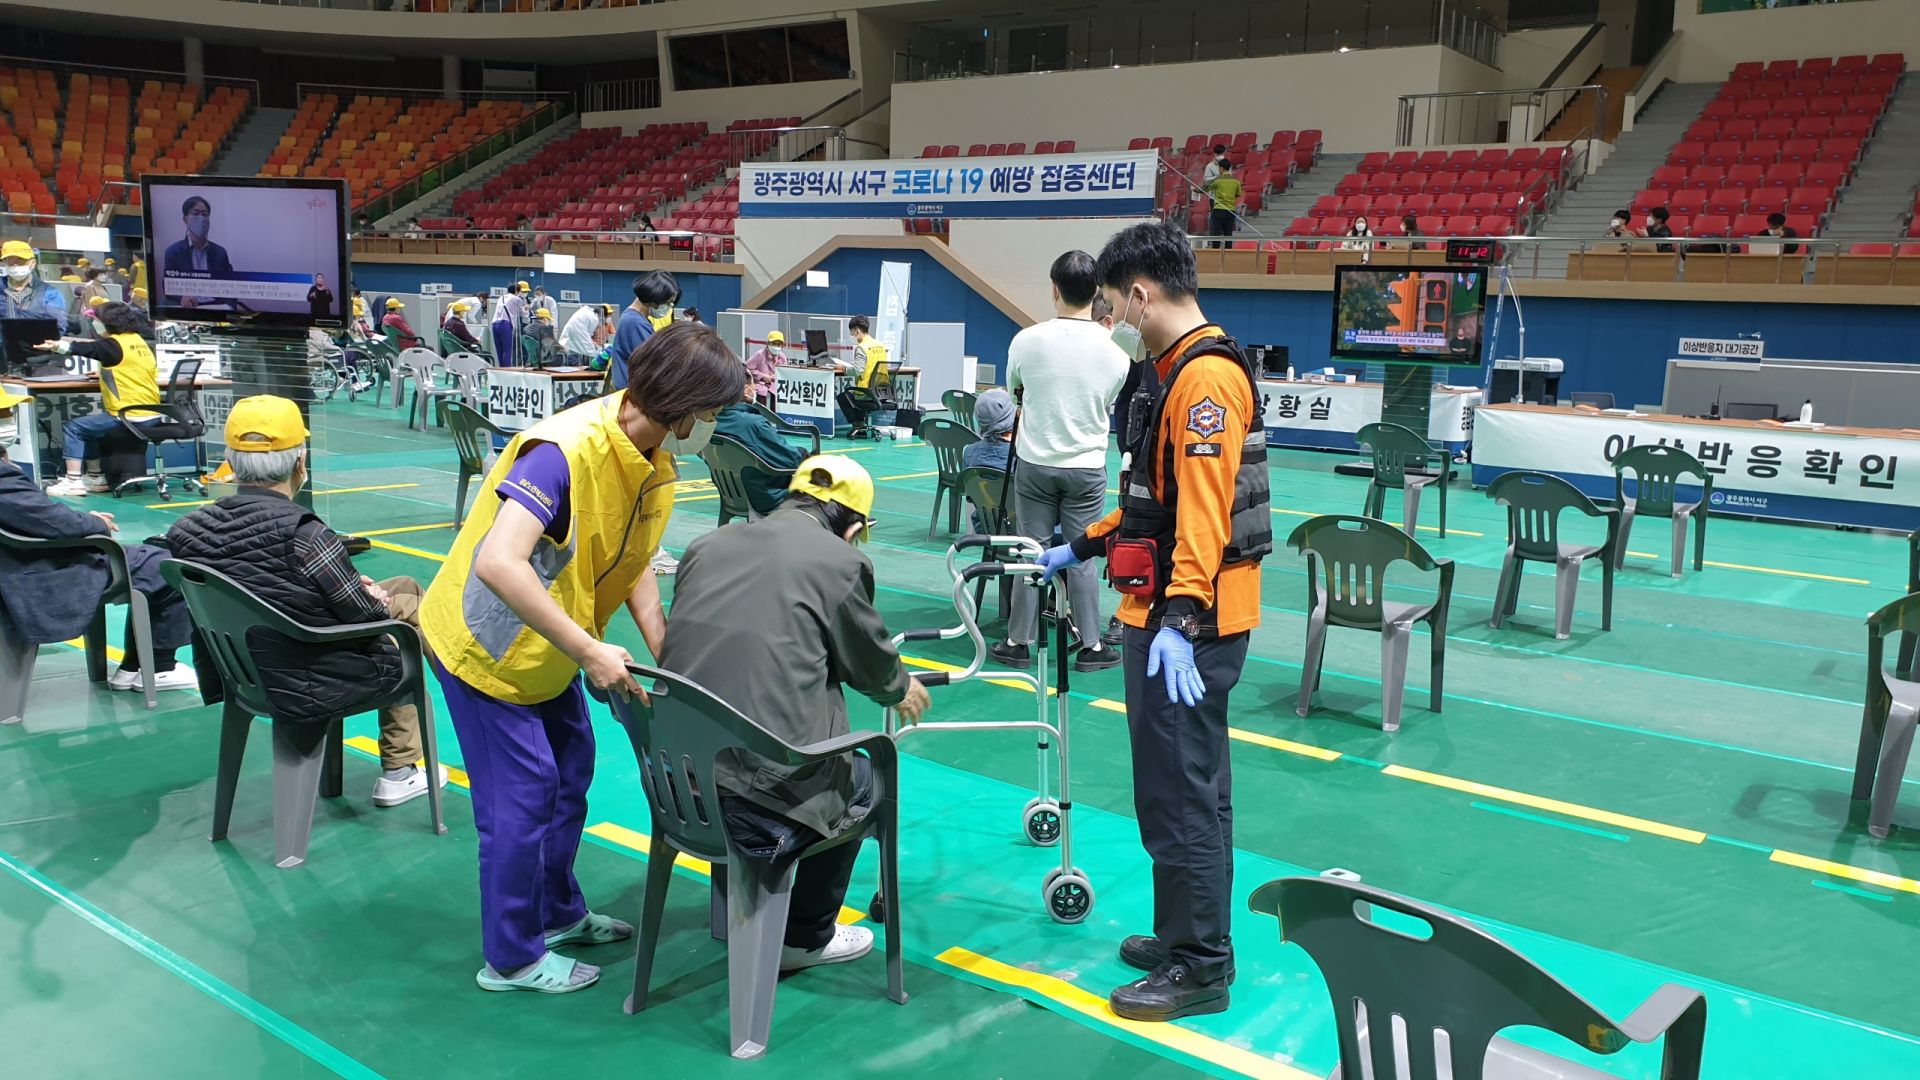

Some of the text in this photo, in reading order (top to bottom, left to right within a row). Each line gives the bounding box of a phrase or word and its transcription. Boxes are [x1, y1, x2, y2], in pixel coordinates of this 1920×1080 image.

[754, 162, 1136, 196] 광주광역시 서구 코로나 19 예방 접종센터
[1683, 341, 1759, 355] 이상반응자 대기공간
[490, 385, 545, 419] 전산확인
[777, 379, 827, 407] 전산확인
[1603, 434, 1897, 490] 이반응확인
